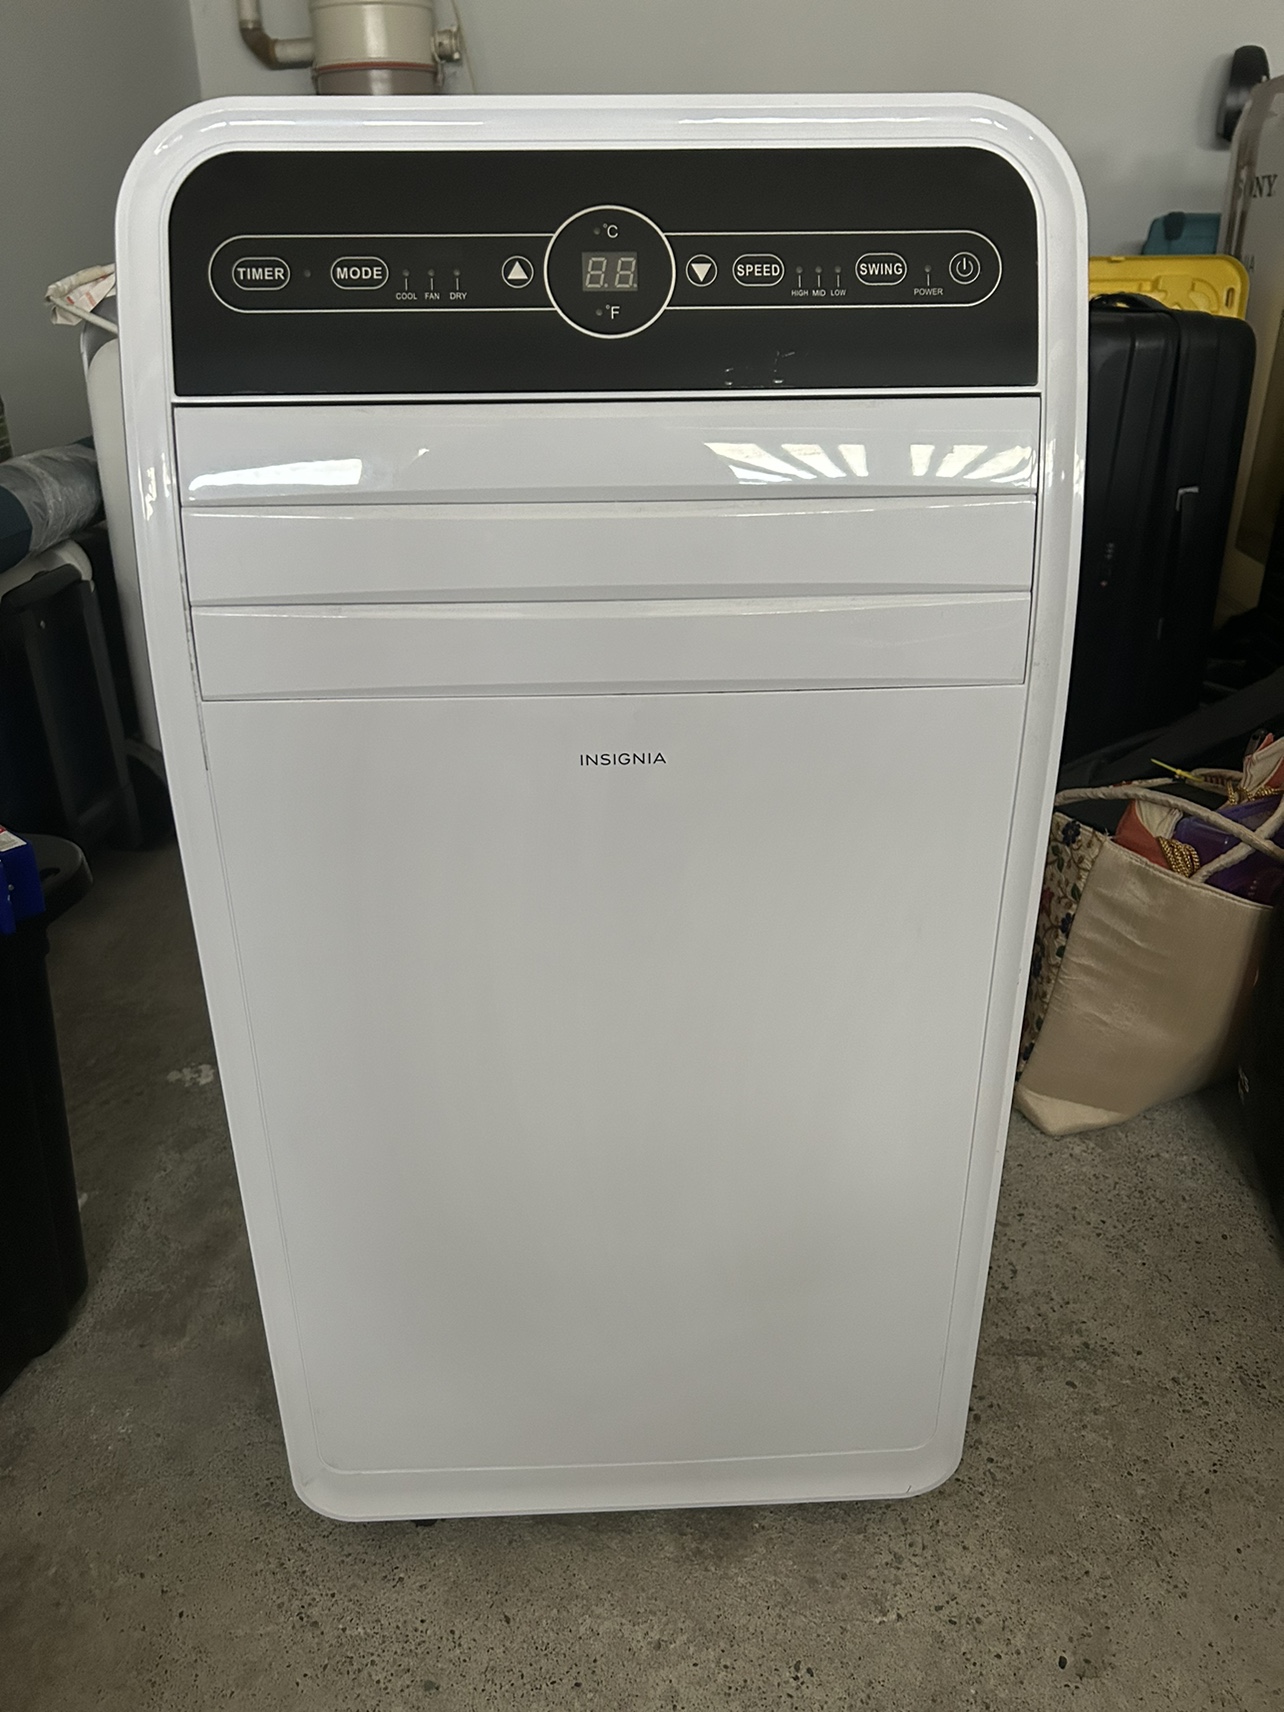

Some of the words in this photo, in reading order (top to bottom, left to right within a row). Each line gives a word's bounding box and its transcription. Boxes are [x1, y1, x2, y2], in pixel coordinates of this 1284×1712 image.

[1237, 174, 1279, 198] SNY
[237, 265, 286, 280] TIMER
[336, 266, 383, 280] MODE
[736, 262, 781, 279] SPEED
[858, 262, 904, 278] SWING
[395, 291, 418, 301] COOL
[424, 292, 440, 300] FAN
[449, 291, 468, 301] DRY
[791, 289, 809, 297] HIGH
[812, 289, 827, 297] MID
[830, 288, 847, 297] LOW
[913, 287, 944, 296] POWER
[580, 752, 667, 766] INSIGNIA
